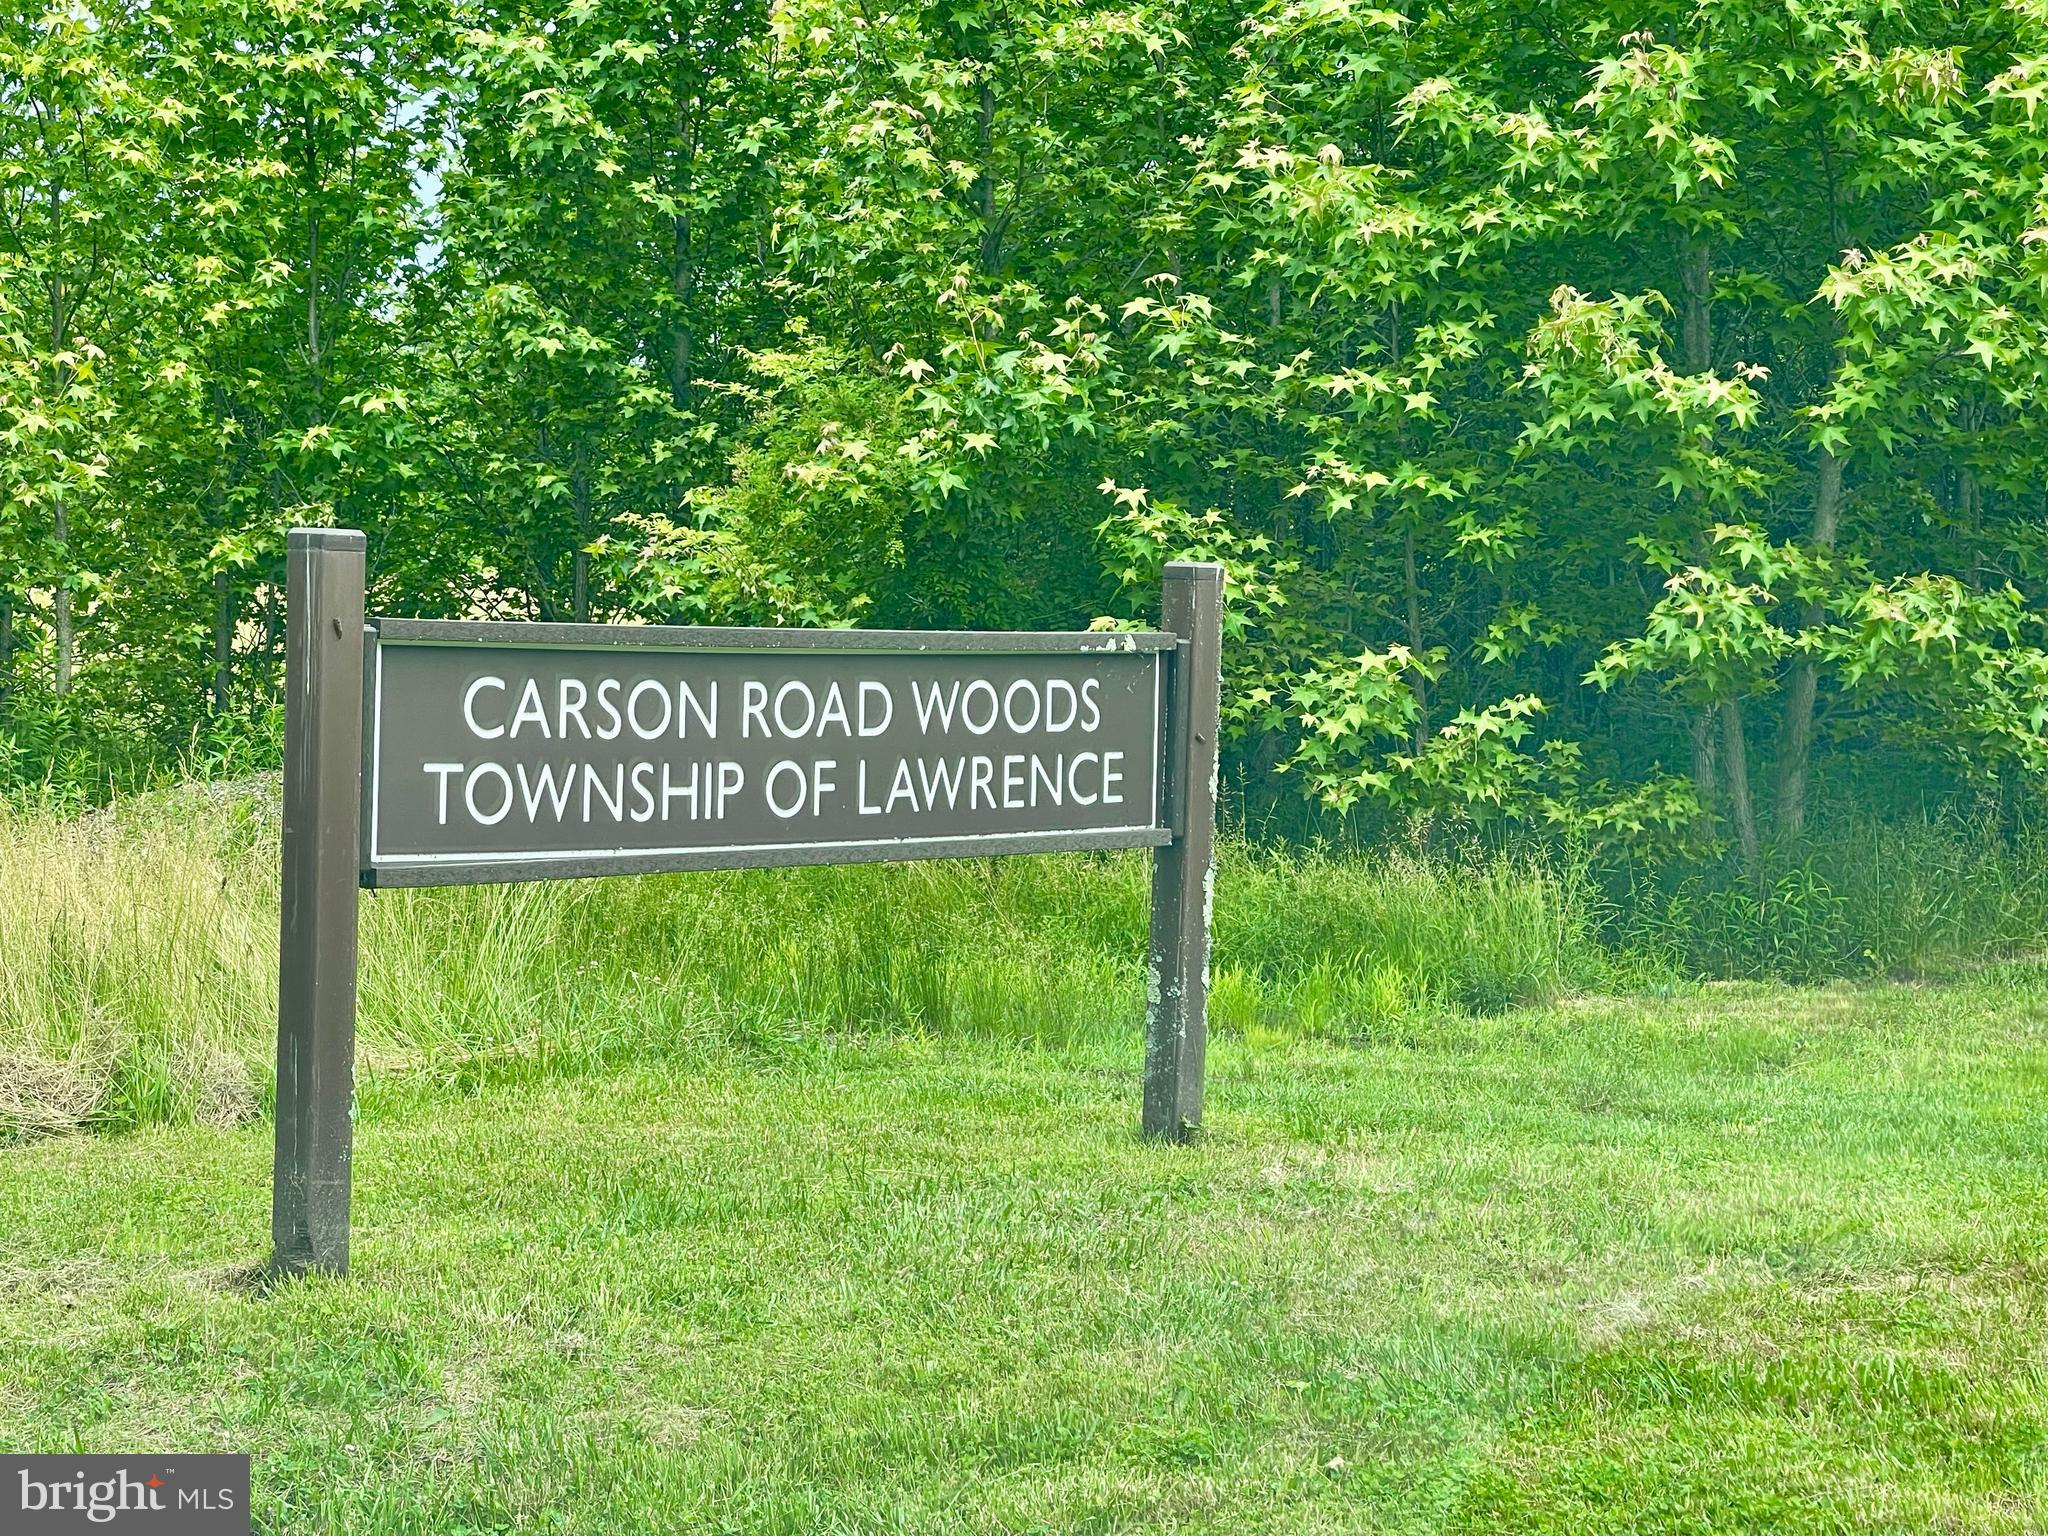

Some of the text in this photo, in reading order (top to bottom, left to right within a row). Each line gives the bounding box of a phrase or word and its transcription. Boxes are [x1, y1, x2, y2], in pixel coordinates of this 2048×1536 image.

[463, 675, 1101, 741] CARSON ROAD WOODS
[423, 752, 1125, 826] TOWNSHIP OF LAWRENCE
